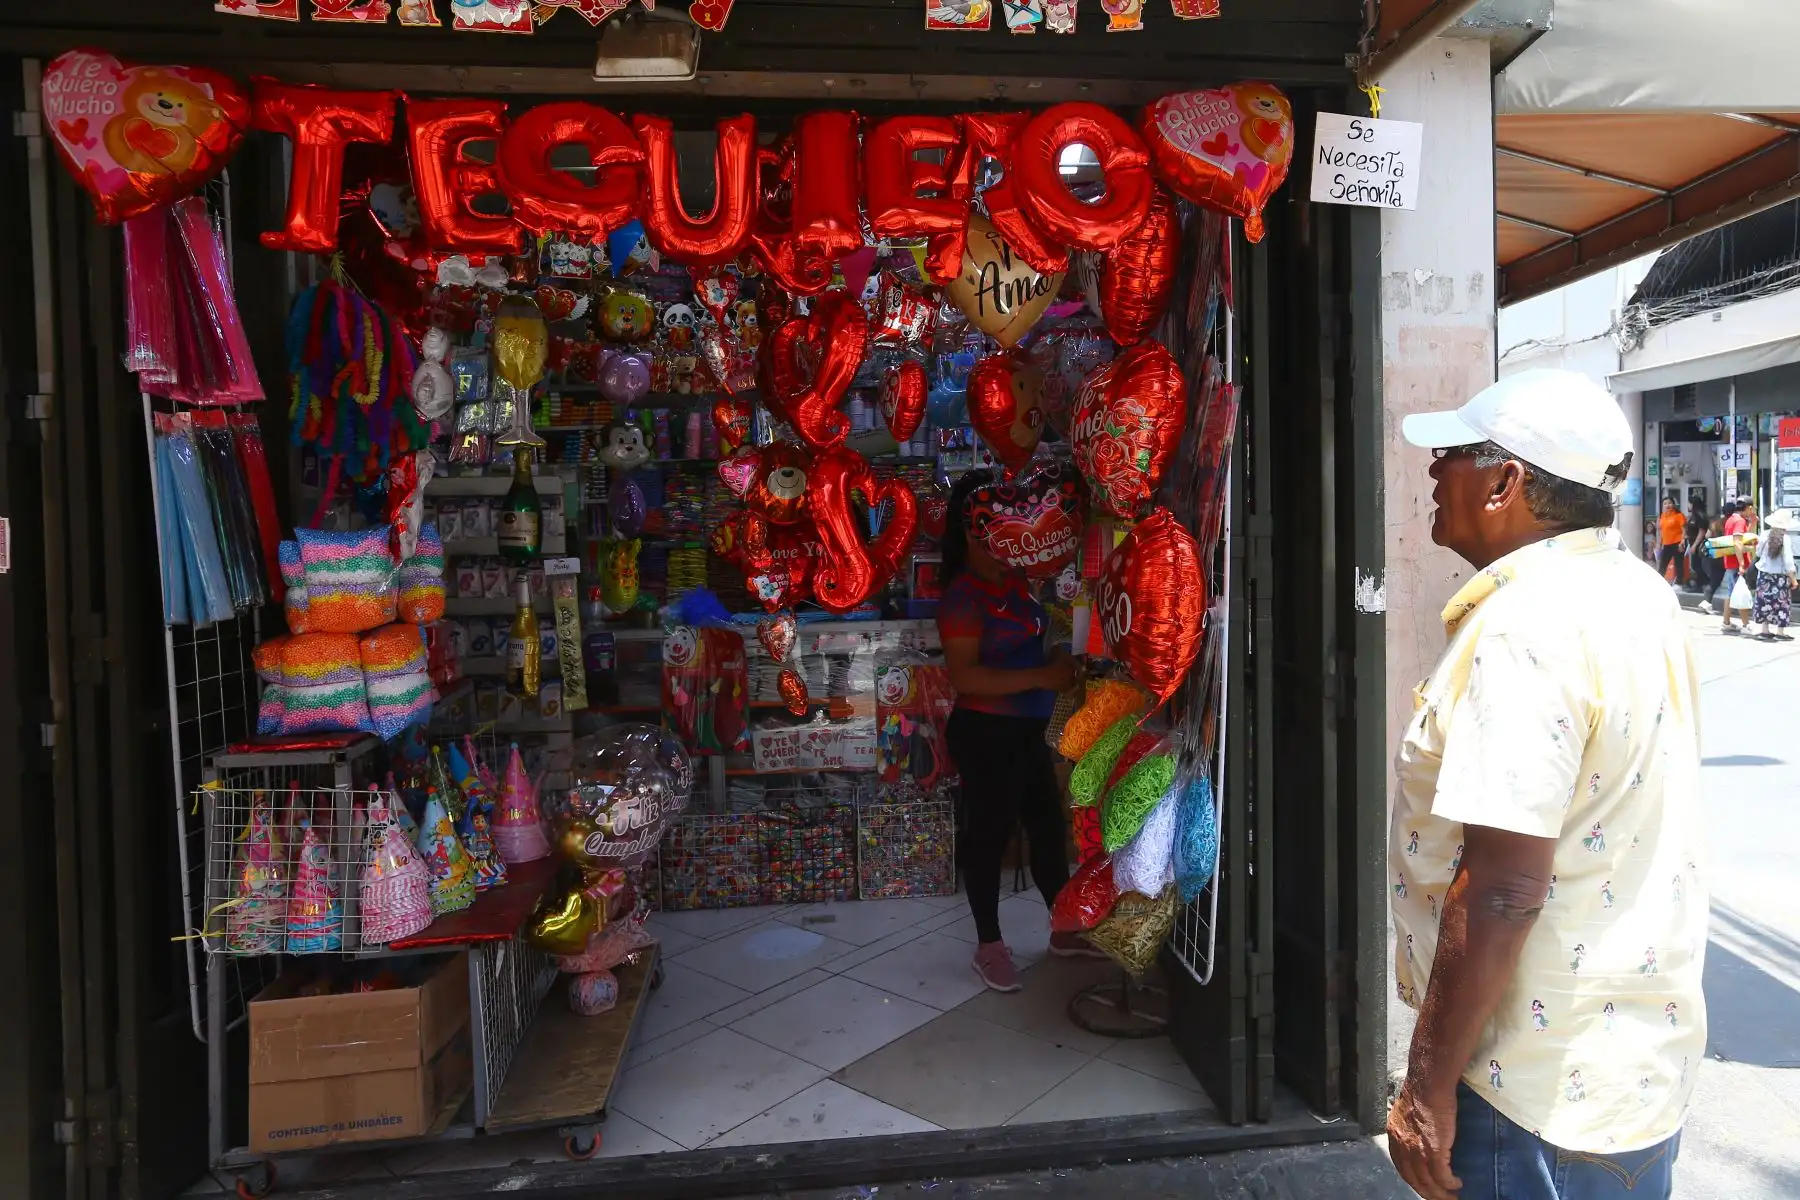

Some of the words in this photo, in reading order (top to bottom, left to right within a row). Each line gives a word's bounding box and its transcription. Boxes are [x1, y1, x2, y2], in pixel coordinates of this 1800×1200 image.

[72, 54, 102, 78] Te
[47, 70, 118, 96] Quiero
[49, 96, 115, 115] Mucho
[1172, 93, 1207, 110] Te
[1165, 99, 1230, 129] Quiero
[1176, 112, 1240, 148] Mucho
[1347, 119, 1375, 143] Se
[974, 261, 1055, 317] Amo
[998, 537, 1022, 556] Te
[1020, 525, 1072, 553] Quiero
[1007, 536, 1078, 567] MUCHO
[774, 737, 788, 747] TE
[813, 748, 826, 758] TE
[348, 1115, 403, 1130] UNIDADES
